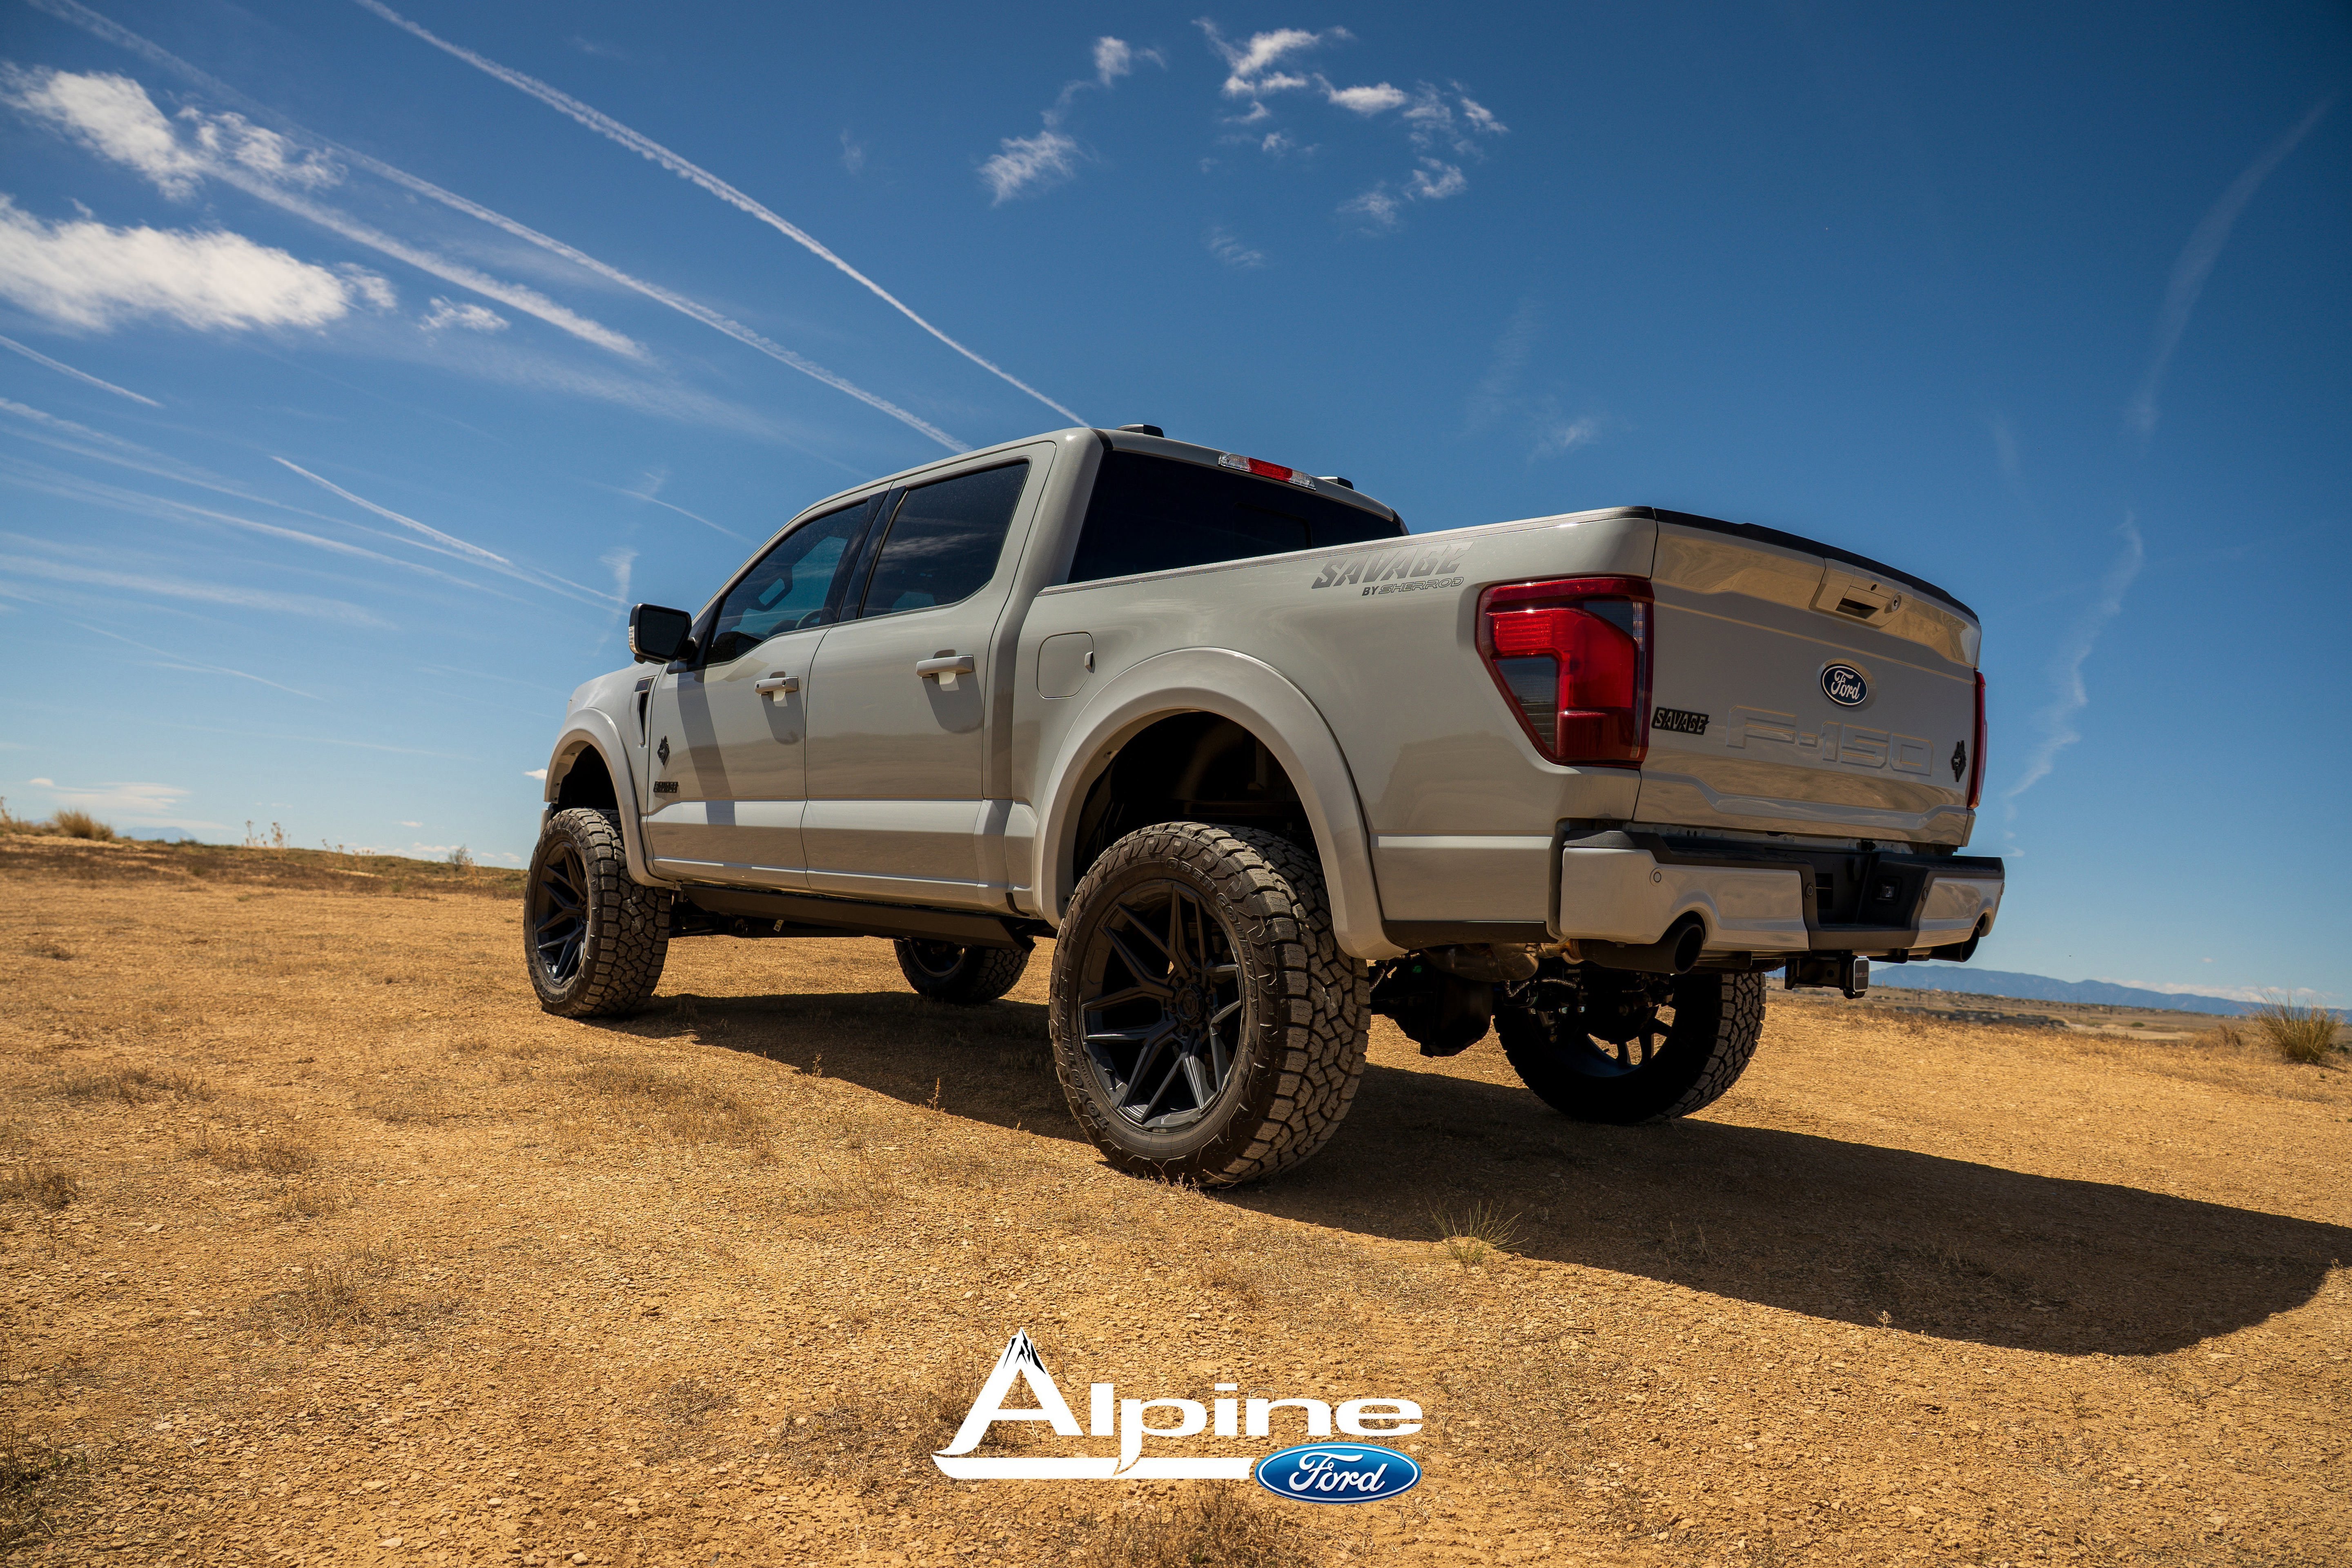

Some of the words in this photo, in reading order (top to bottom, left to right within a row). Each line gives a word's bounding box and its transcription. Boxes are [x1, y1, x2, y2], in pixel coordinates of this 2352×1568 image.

[1312, 541, 1474, 589] SAVAGE
[1362, 586, 1380, 596] BY
[1379, 577, 1464, 594] SHERROD
[1831, 670, 1860, 700] Ford
[1654, 709, 1708, 733] SAVAGE
[1726, 705, 1934, 776] F-150
[1166, 857, 1217, 892] OPEN
[1216, 893, 1258, 1019] COUNTRY
[1060, 976, 1076, 1066] TIRES
[1071, 1069, 1109, 1132] TOYO
